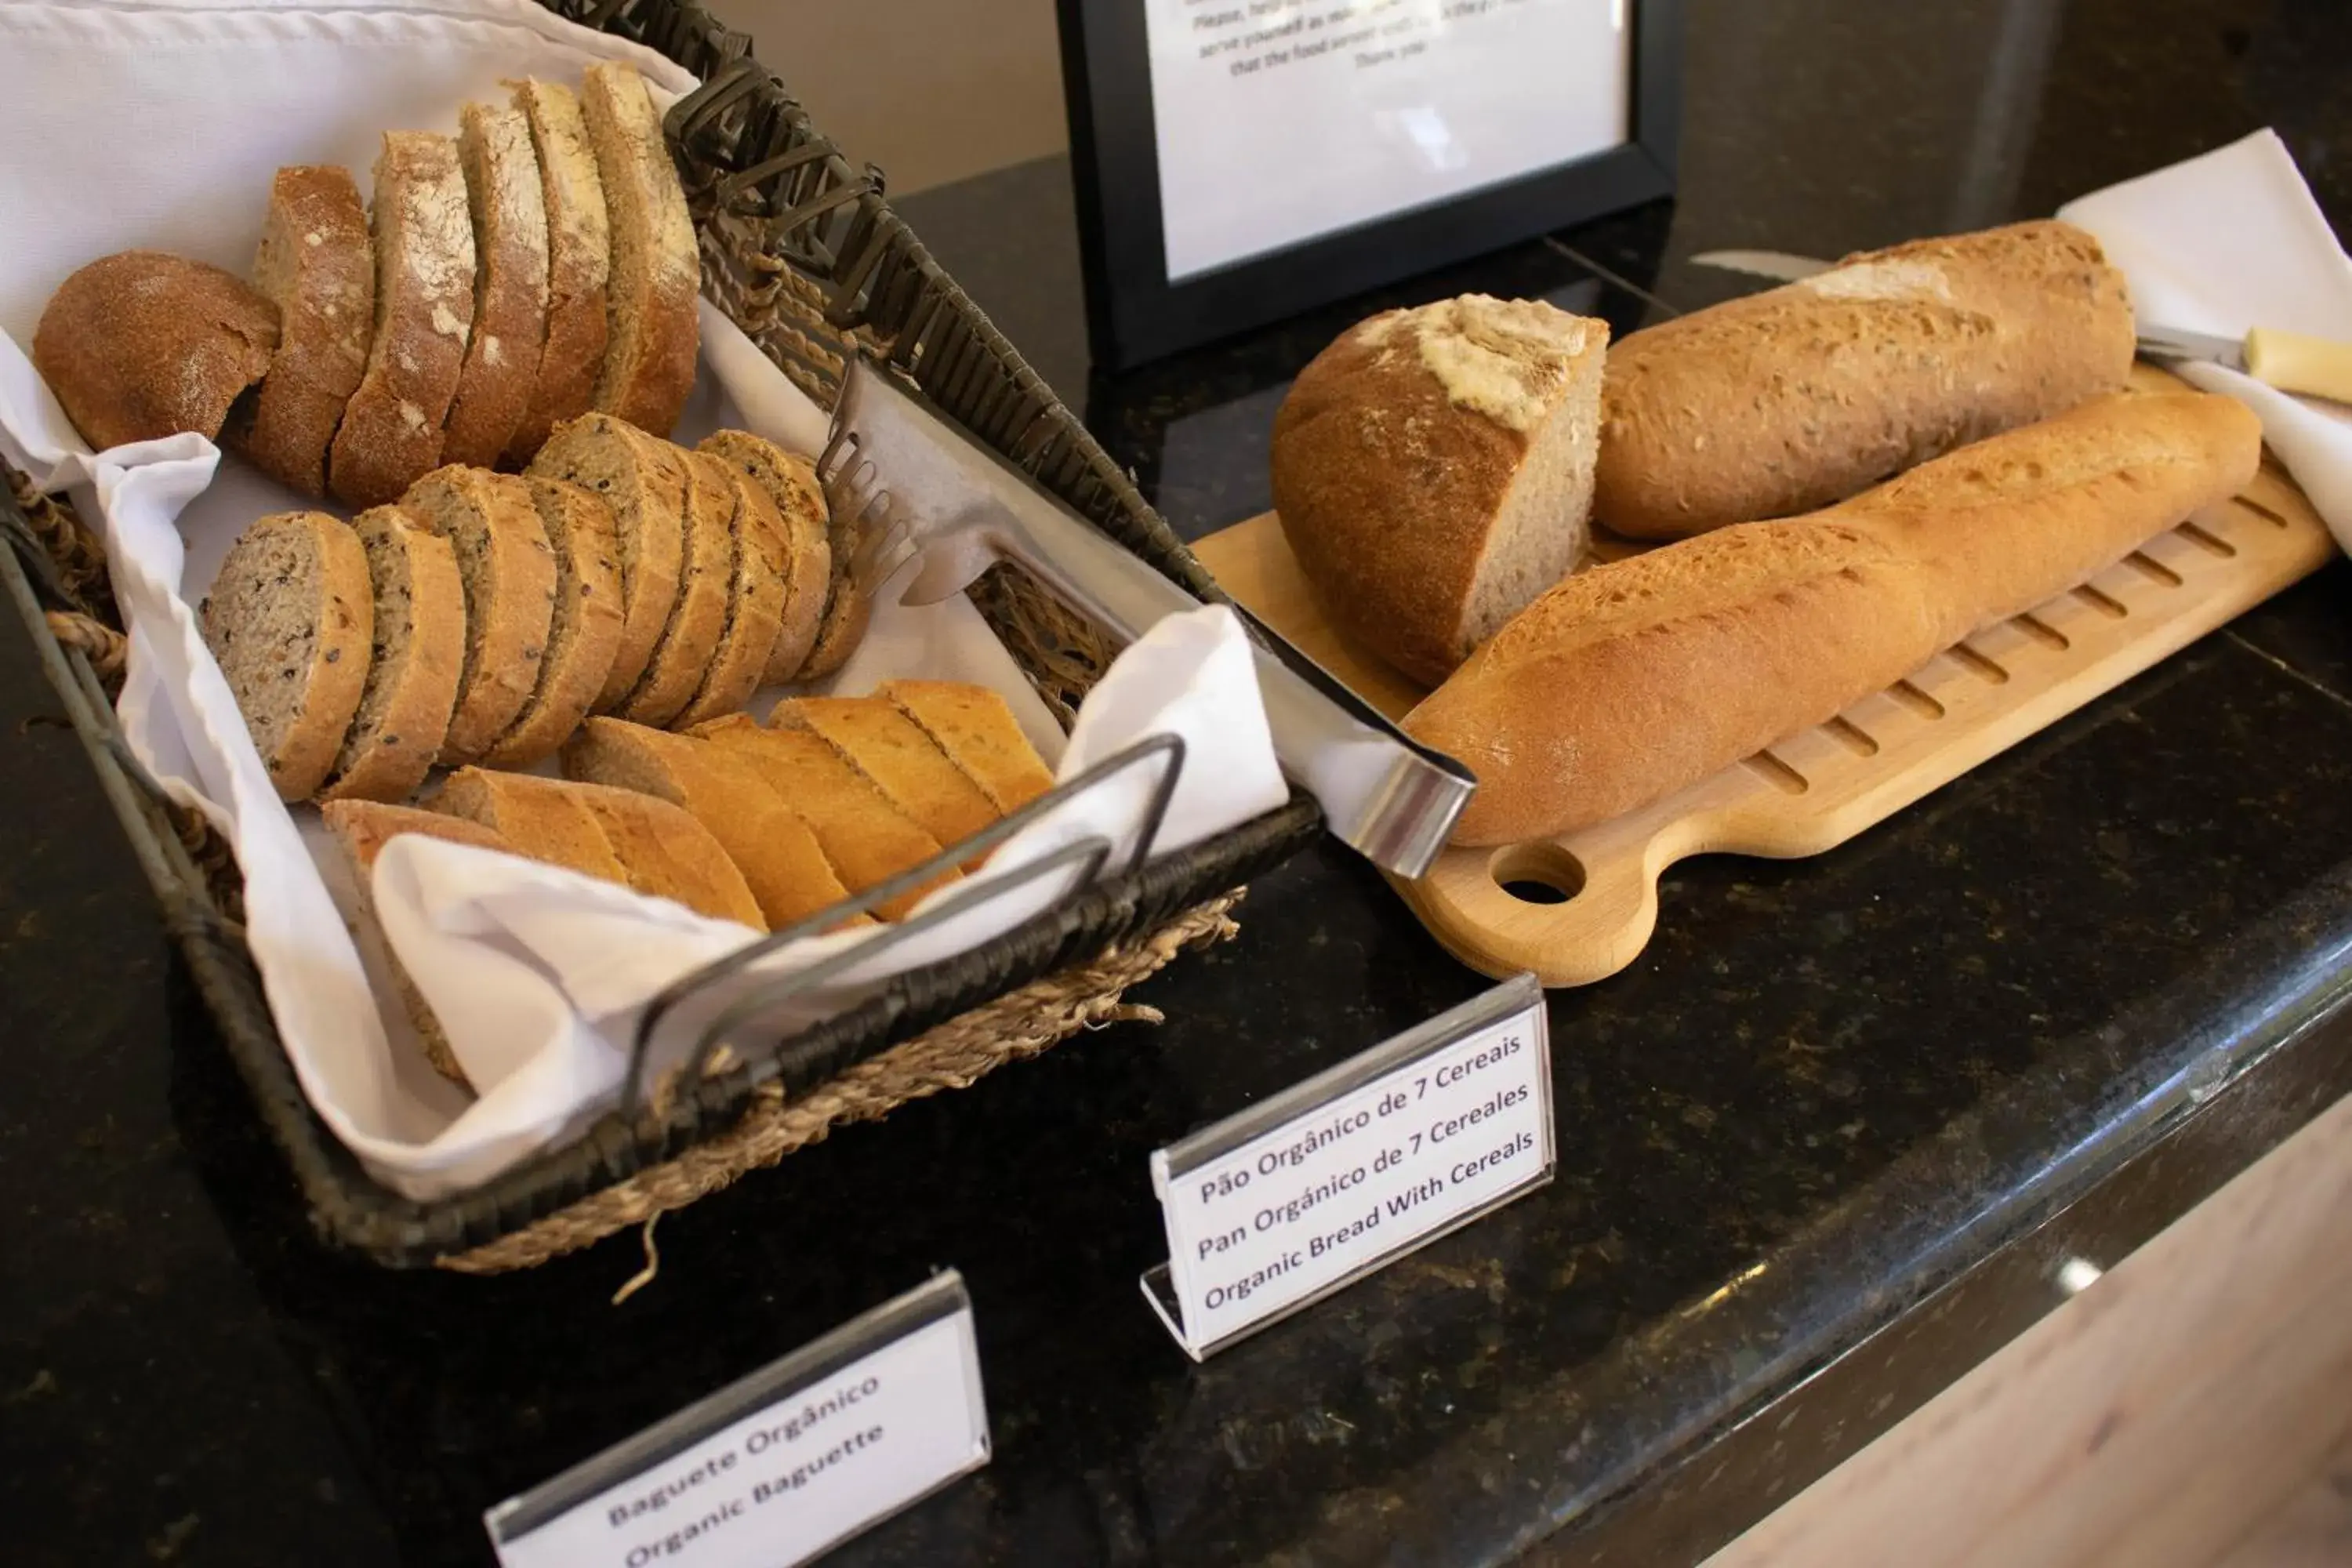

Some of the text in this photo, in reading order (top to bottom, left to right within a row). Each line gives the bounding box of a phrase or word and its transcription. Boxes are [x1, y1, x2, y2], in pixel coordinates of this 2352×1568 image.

[1230, 57, 1260, 77] that
[1265, 51, 1288, 67] the
[1294, 38, 1327, 60] food
[1244, 15, 1304, 49] yourself
[1199, 1082, 1528, 1260] Pan Orgánico de 7 Cereales
[1201, 1033, 1520, 1203] Pão Orgânico de 7 Cereais
[1205, 1131, 1534, 1310] Organic Bread With Cereals
[608, 1374, 880, 1530] Baguete Orgânico
[625, 1423, 885, 1568] Organic Baguette
